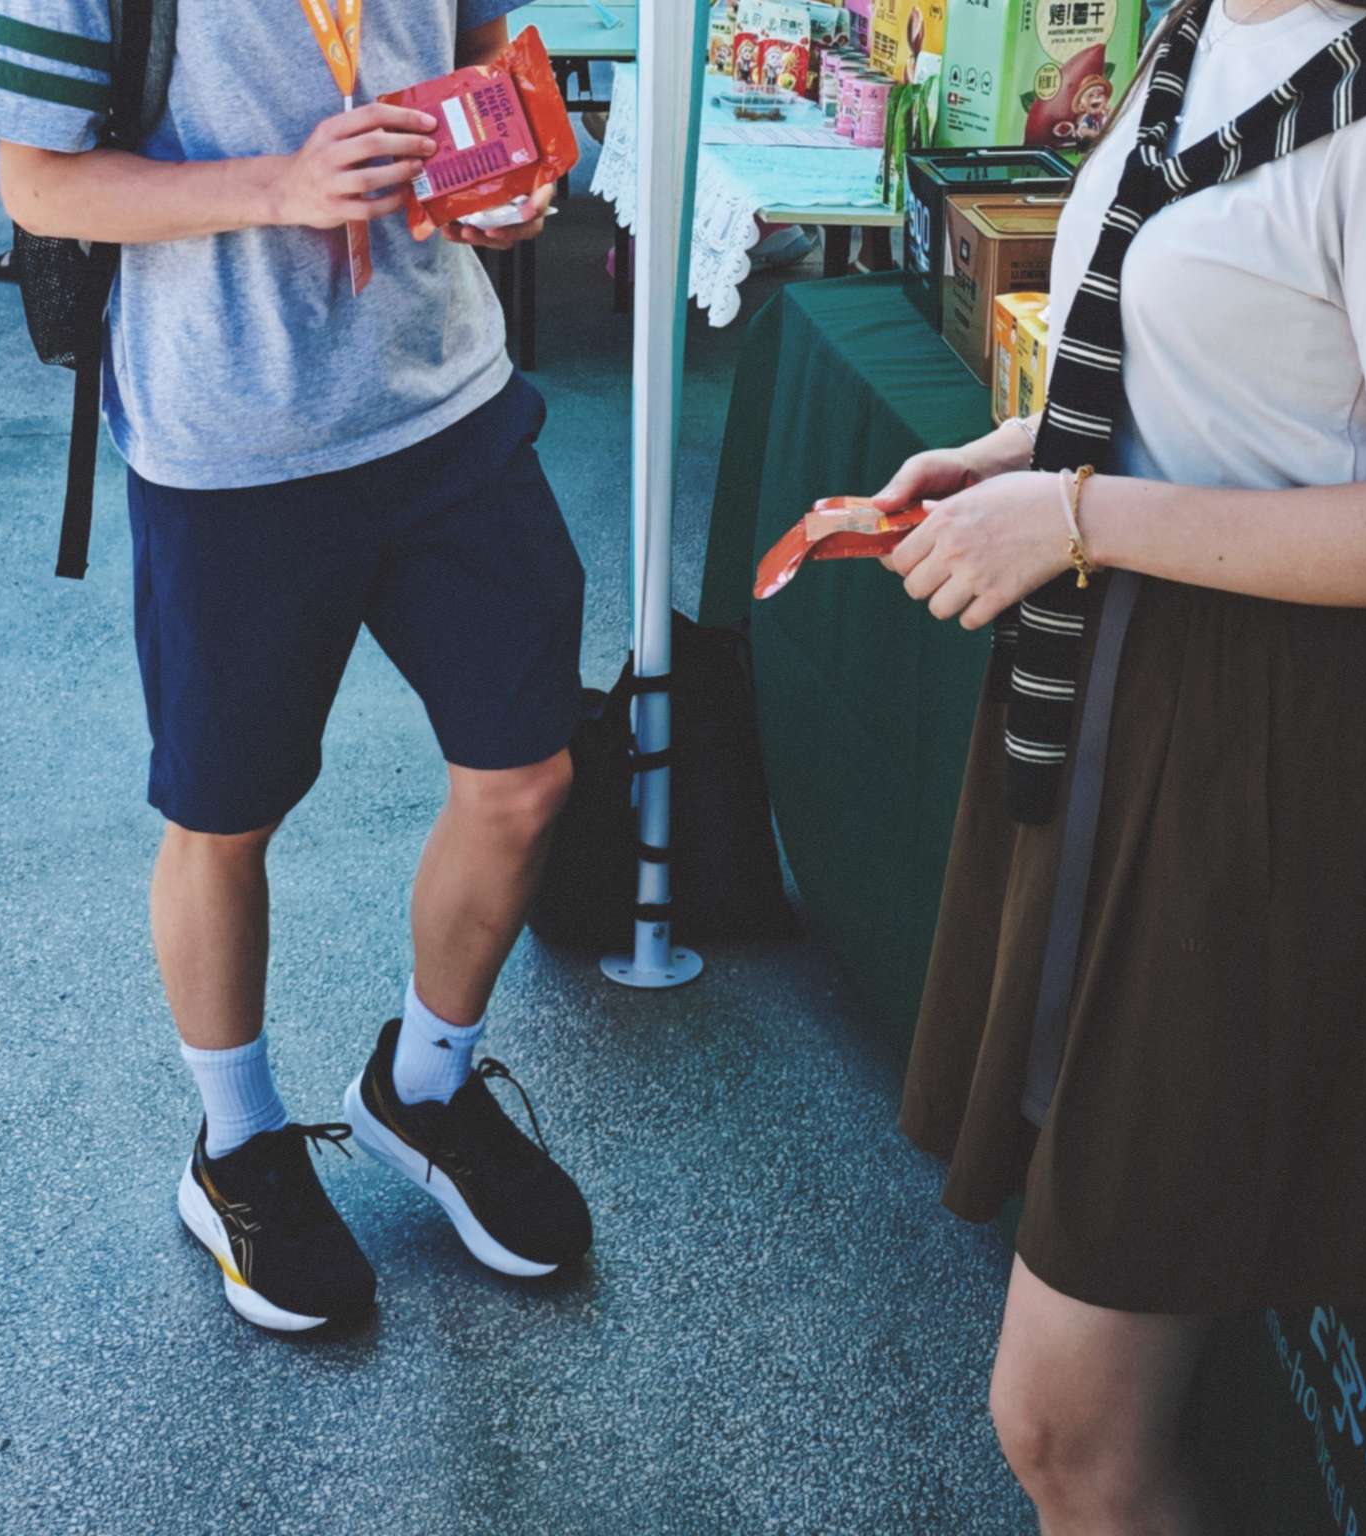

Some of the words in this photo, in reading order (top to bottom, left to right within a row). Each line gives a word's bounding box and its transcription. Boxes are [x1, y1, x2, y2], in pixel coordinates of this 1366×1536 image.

[473, 91, 490, 119] BAR
[483, 86, 510, 139] ENERGY
[493, 82, 514, 118] HIGH
